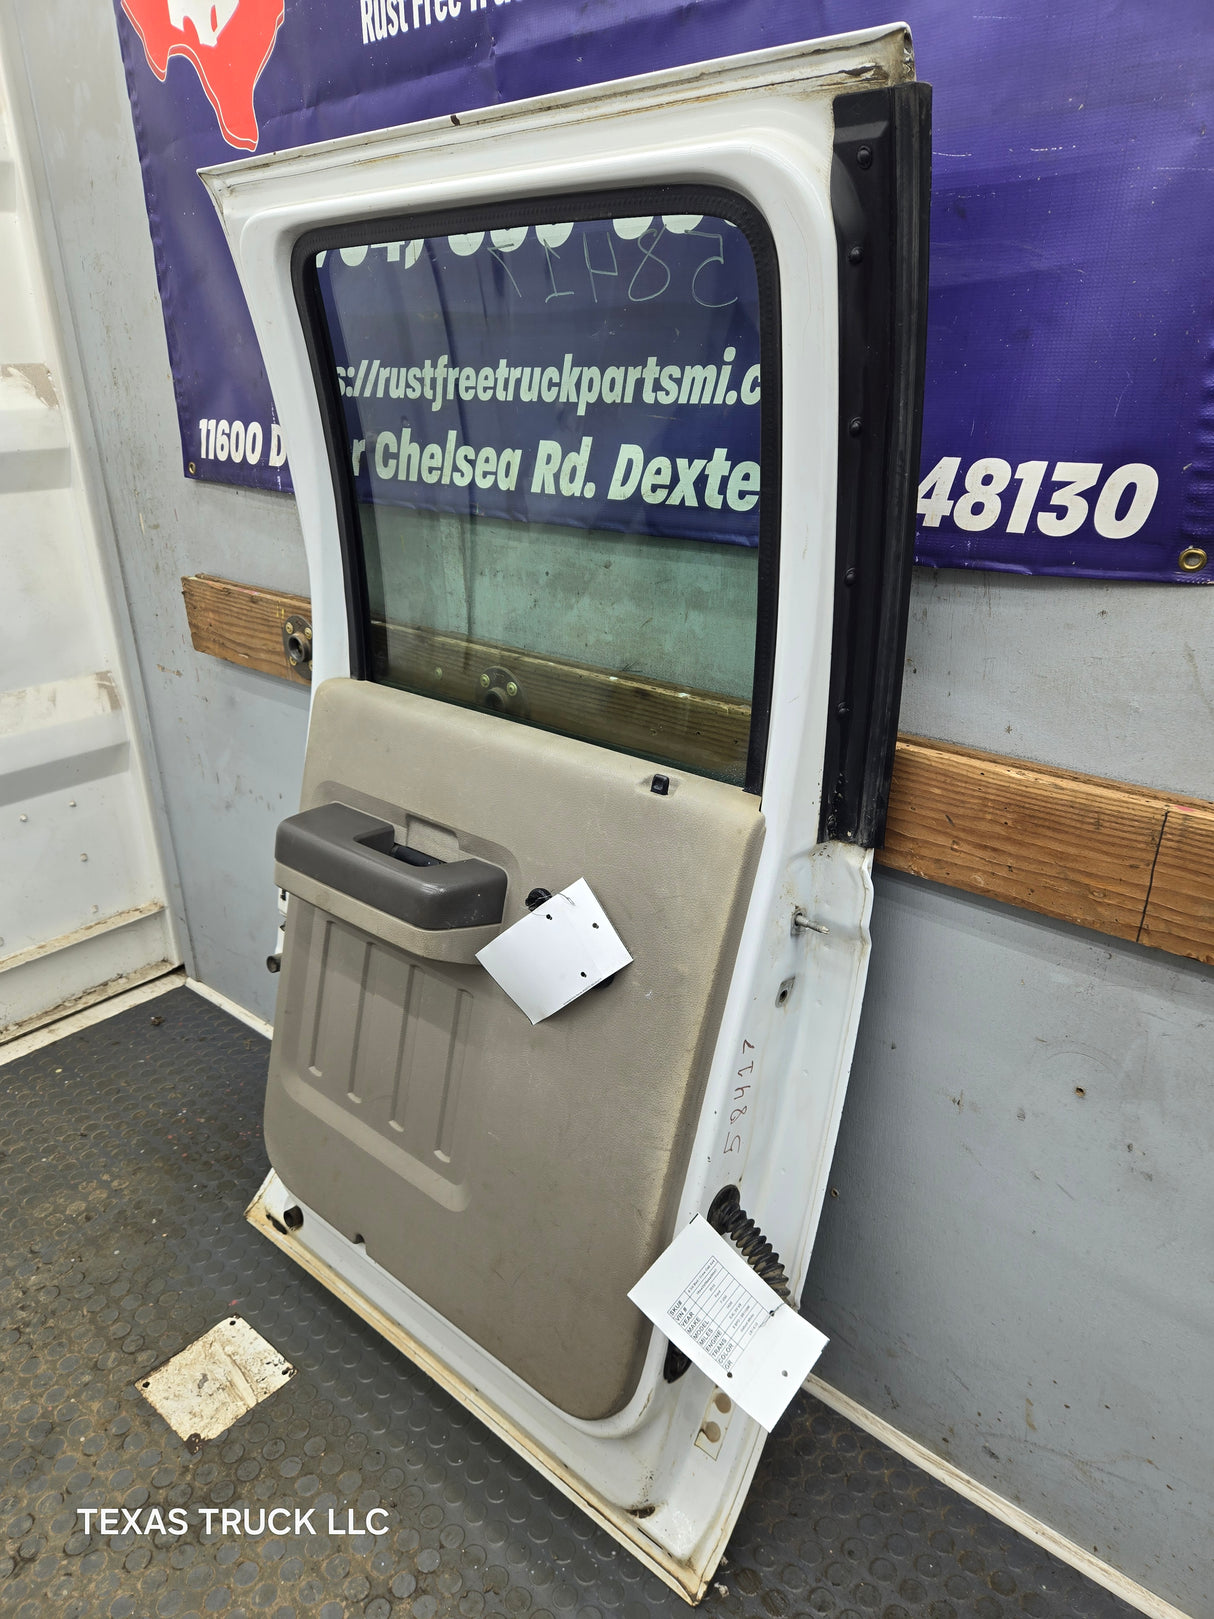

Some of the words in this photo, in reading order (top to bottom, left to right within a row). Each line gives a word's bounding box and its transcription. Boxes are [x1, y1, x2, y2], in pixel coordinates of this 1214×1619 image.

[360, 0, 409, 44] Rust
[199, 418, 263, 465] 11600
[374, 427, 523, 491] Chelsea
[530, 436, 597, 499] Rd.
[916, 456, 1159, 539] 48130
[723, 1039, 755, 1153] 58417
[680, 1311, 695, 1328] YEAR
[686, 1316, 701, 1334] MAKE
[692, 1318, 710, 1340] MODEL
[699, 1327, 714, 1346] MILES
[705, 1329, 722, 1352] ENGINE
[711, 1337, 727, 1358] TRANS
[718, 1342, 734, 1364] COLOR
